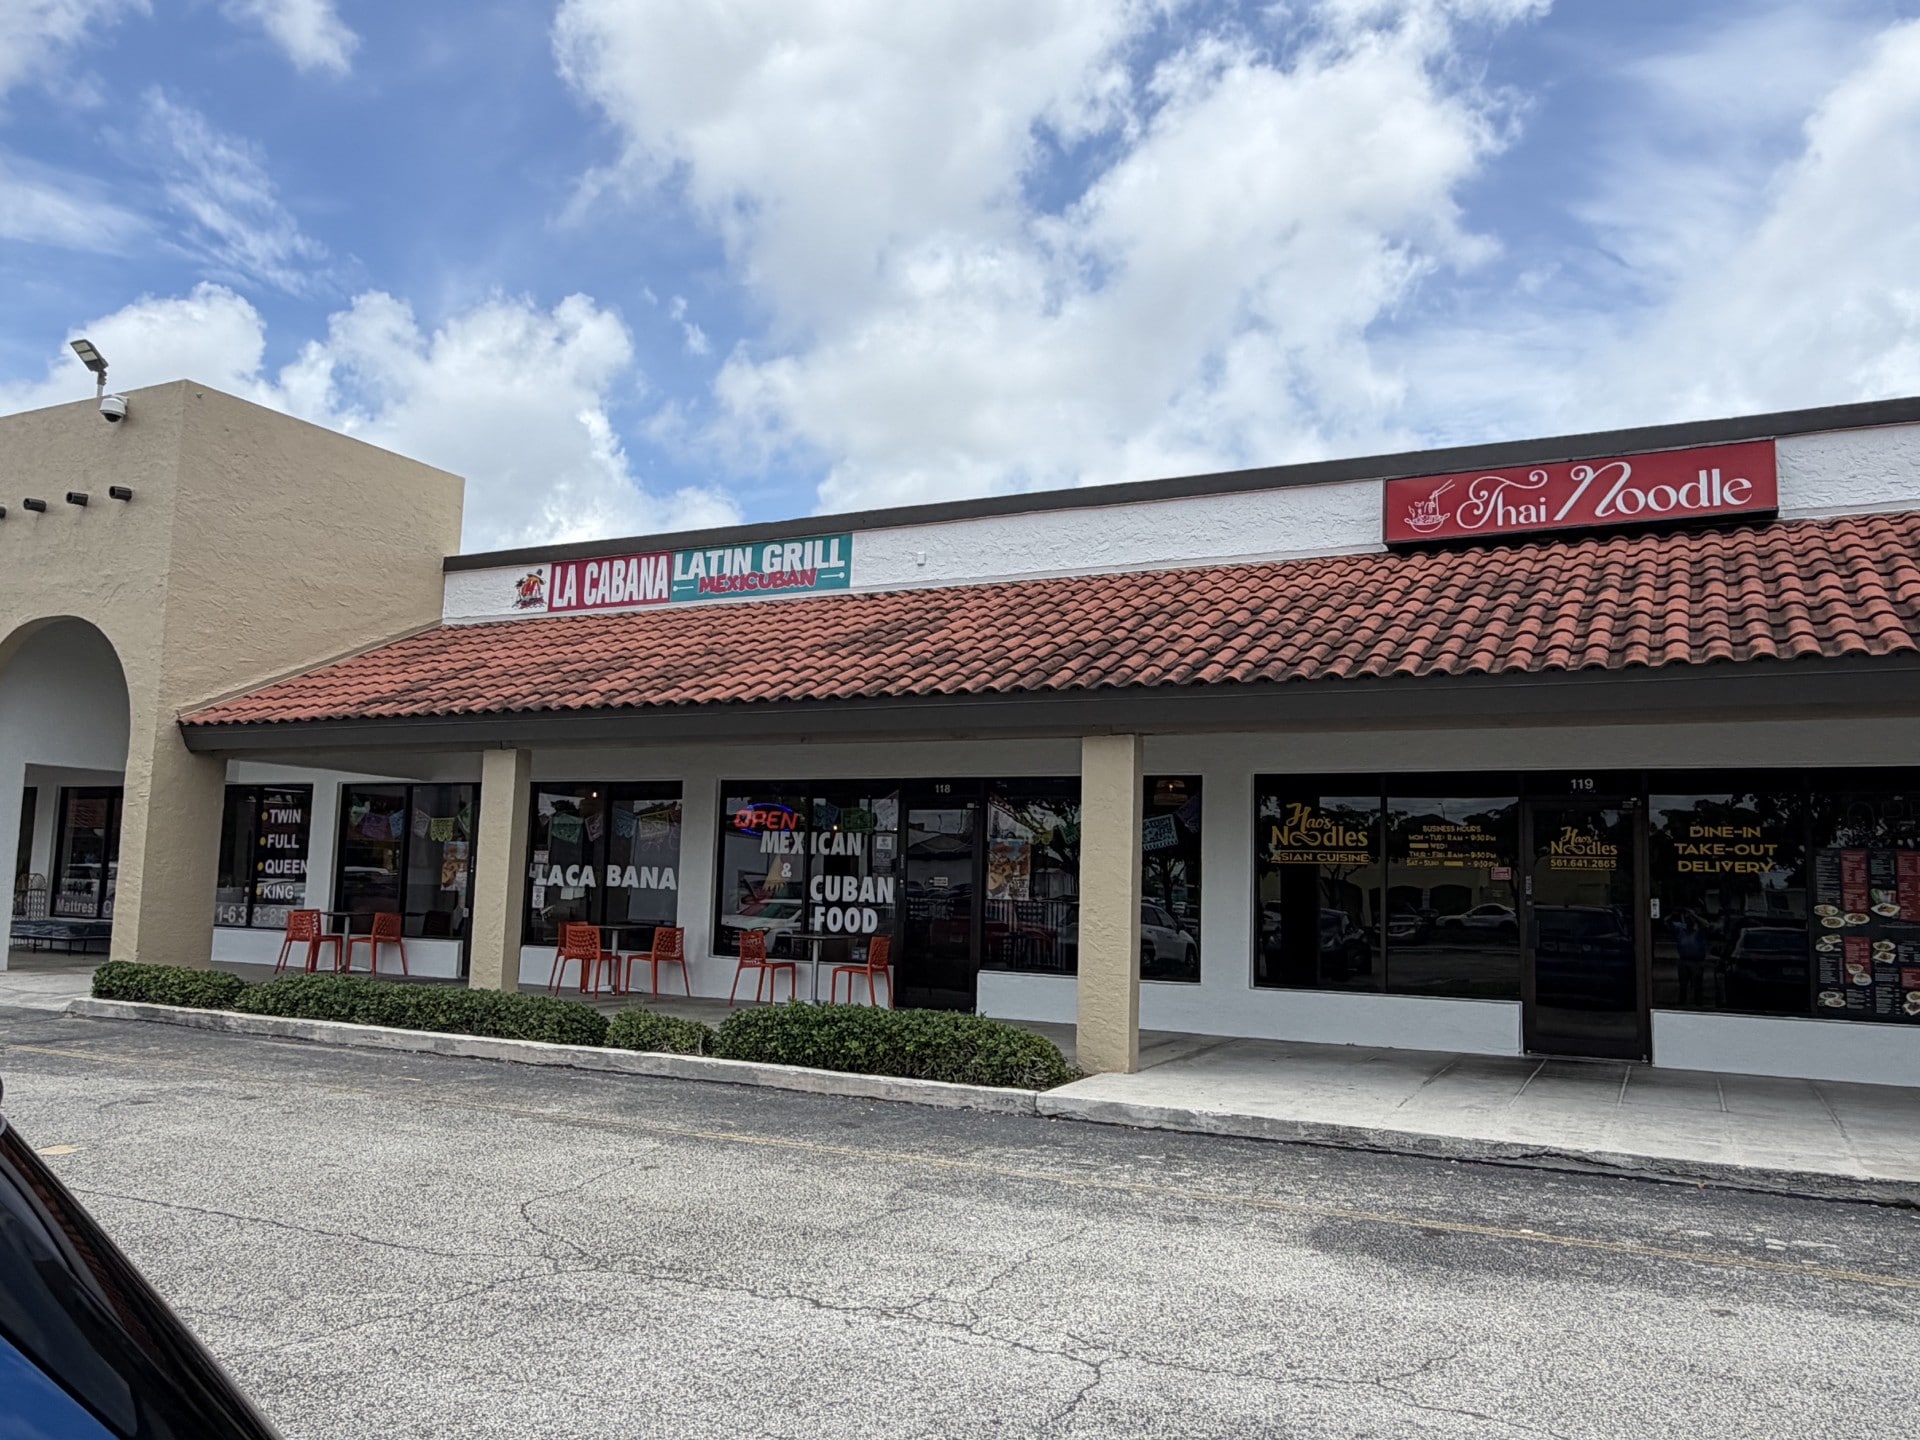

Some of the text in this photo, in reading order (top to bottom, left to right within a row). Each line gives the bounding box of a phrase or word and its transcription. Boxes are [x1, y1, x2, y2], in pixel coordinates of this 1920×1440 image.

[1456, 461, 1753, 530] Thai Noodle
[673, 538, 846, 582] LATIN GRILL
[552, 555, 669, 608] LA CABANA
[697, 568, 819, 595] MEXICUBAN
[935, 784, 951, 794] 118
[1570, 778, 1594, 790] 119
[269, 809, 302, 824] TWIN
[733, 809, 799, 831] OPEN
[1285, 802, 1336, 834] Hao's
[1271, 825, 1369, 848] Noodles
[1422, 825, 1481, 833] BUSINESS HOURS
[1689, 826, 1761, 839] DINE-IN
[266, 834, 300, 849] FULL
[759, 830, 863, 856] MEXICAN
[1550, 841, 1618, 855] Noodles
[1673, 843, 1779, 856] TAKE-OUT
[1270, 852, 1370, 863] ASIAN CUISINE
[264, 859, 309, 875] QUEEN
[781, 862, 792, 878] &
[1676, 860, 1776, 875] DELIVERY
[535, 863, 678, 891] LACA BANA
[262, 885, 294, 899] KING
[809, 874, 894, 904] CUBAN
[55, 899, 98, 914] Mattress
[813, 906, 879, 934] FOOD
